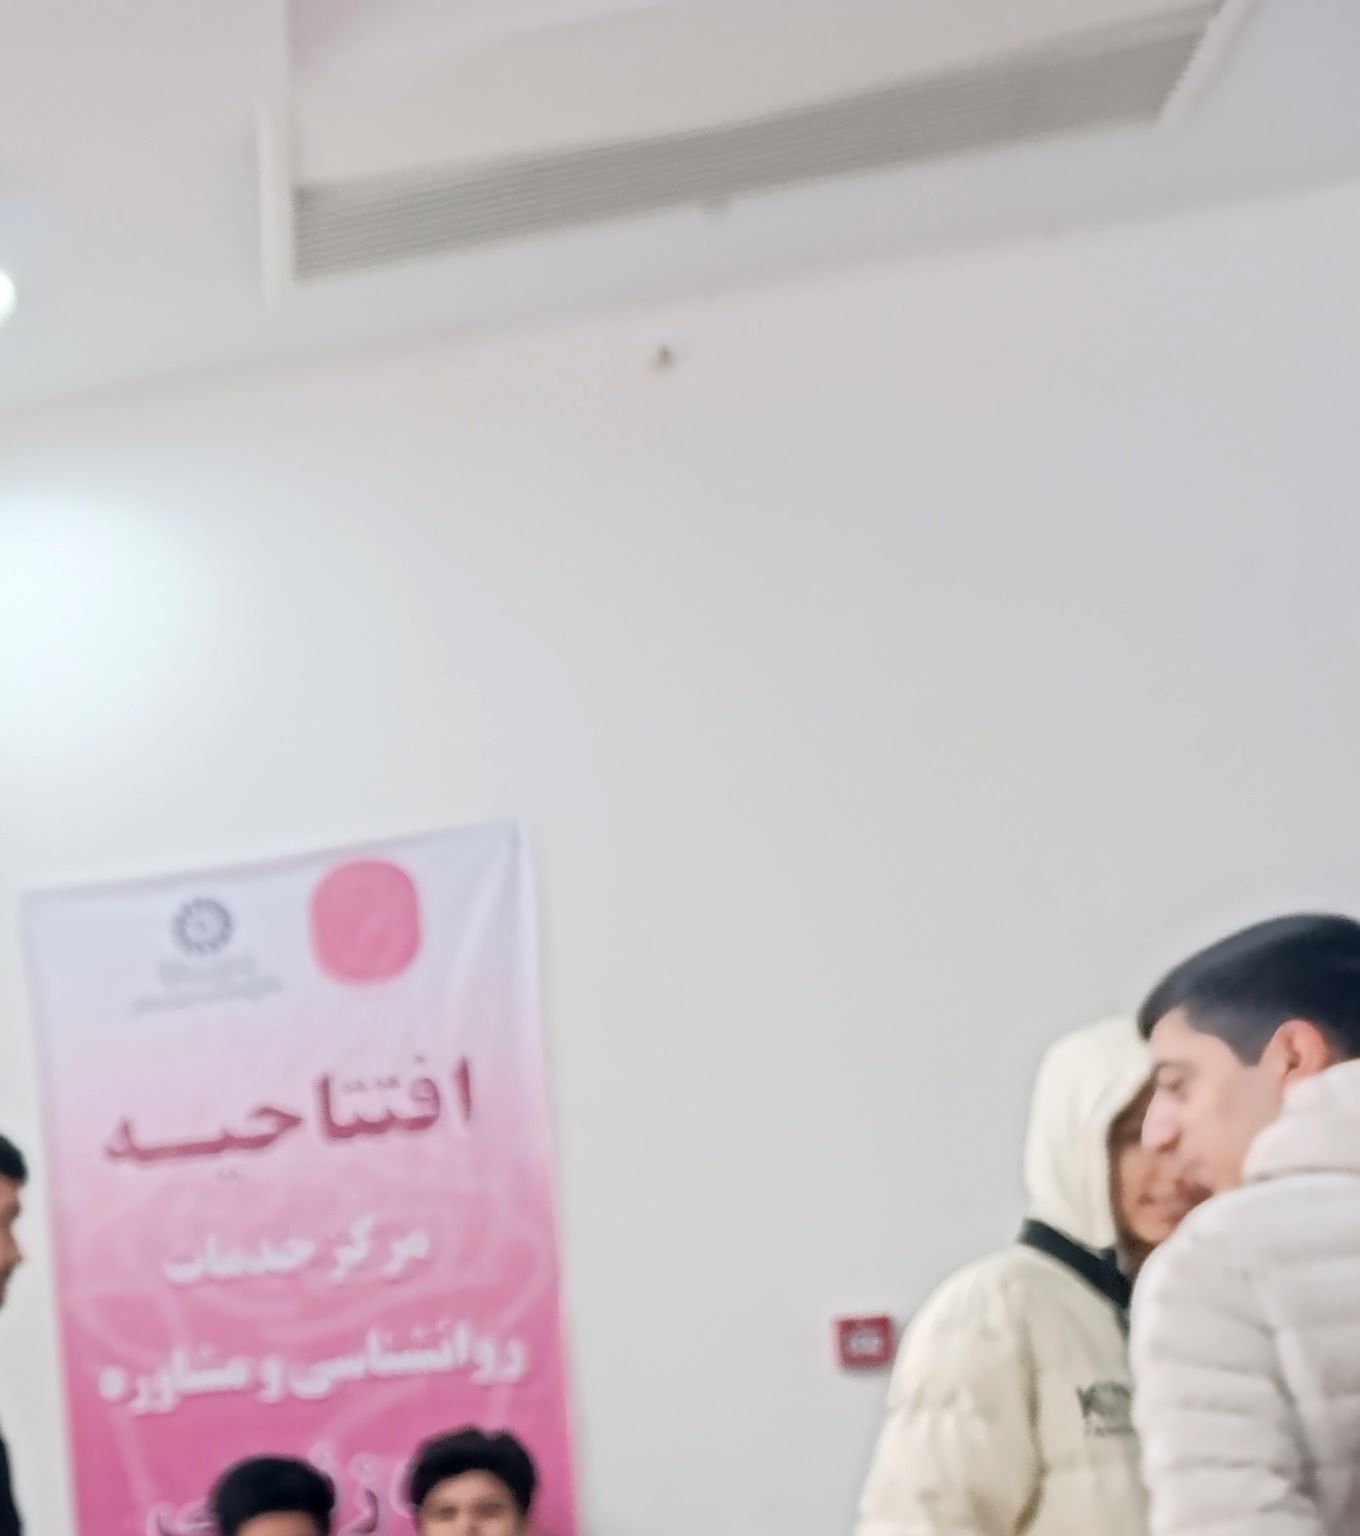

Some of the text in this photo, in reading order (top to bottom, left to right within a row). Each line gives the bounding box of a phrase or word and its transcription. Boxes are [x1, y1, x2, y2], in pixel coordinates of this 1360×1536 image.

[105, 1054, 473, 1182] افتتاحیه
[163, 1214, 431, 1285] مرکز خدمات
[97, 1317, 527, 1417] روانشناسی و مشاوره
